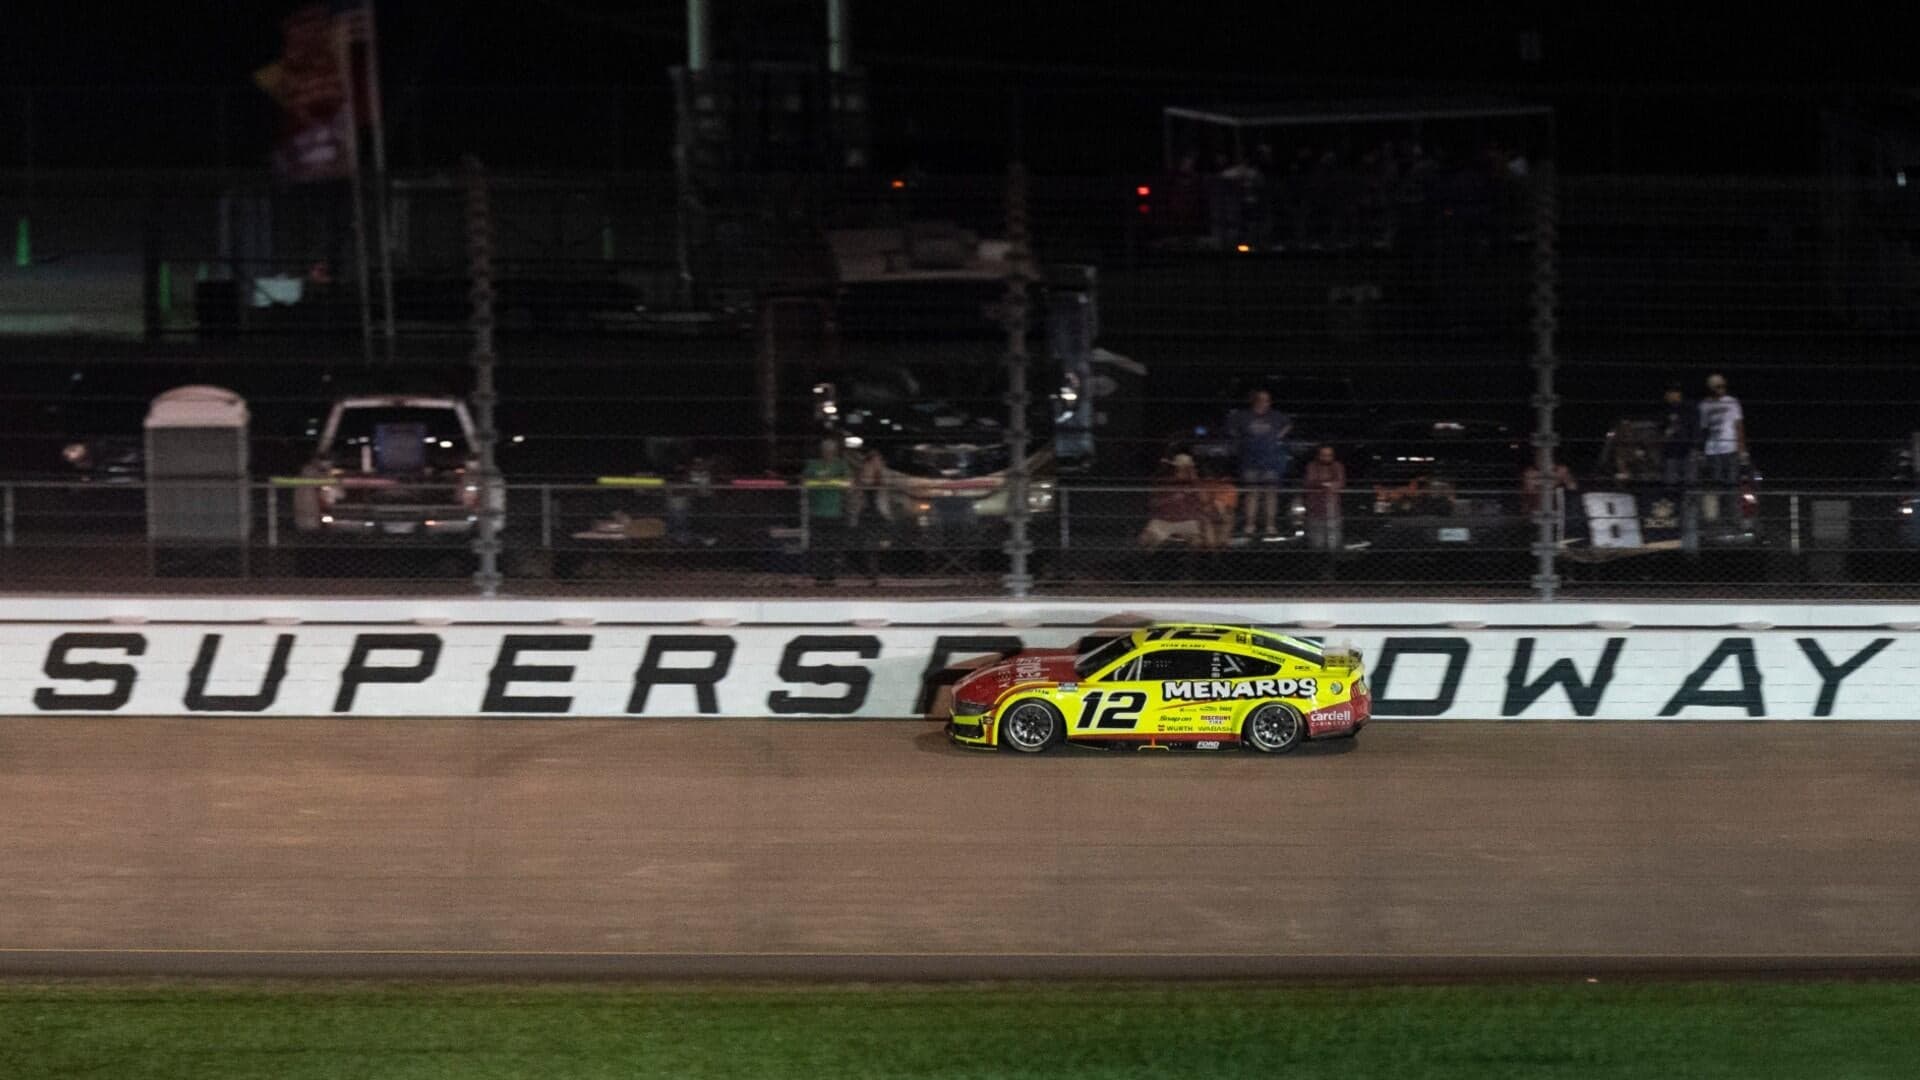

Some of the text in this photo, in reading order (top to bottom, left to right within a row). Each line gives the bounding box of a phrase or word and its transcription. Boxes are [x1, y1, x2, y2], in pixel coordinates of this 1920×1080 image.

[32, 632, 1896, 717] SUPERSPDWAY
[1163, 678, 1317, 702] MENARDS
[1076, 691, 1149, 729] 12
[1310, 710, 1351, 721] cardell
